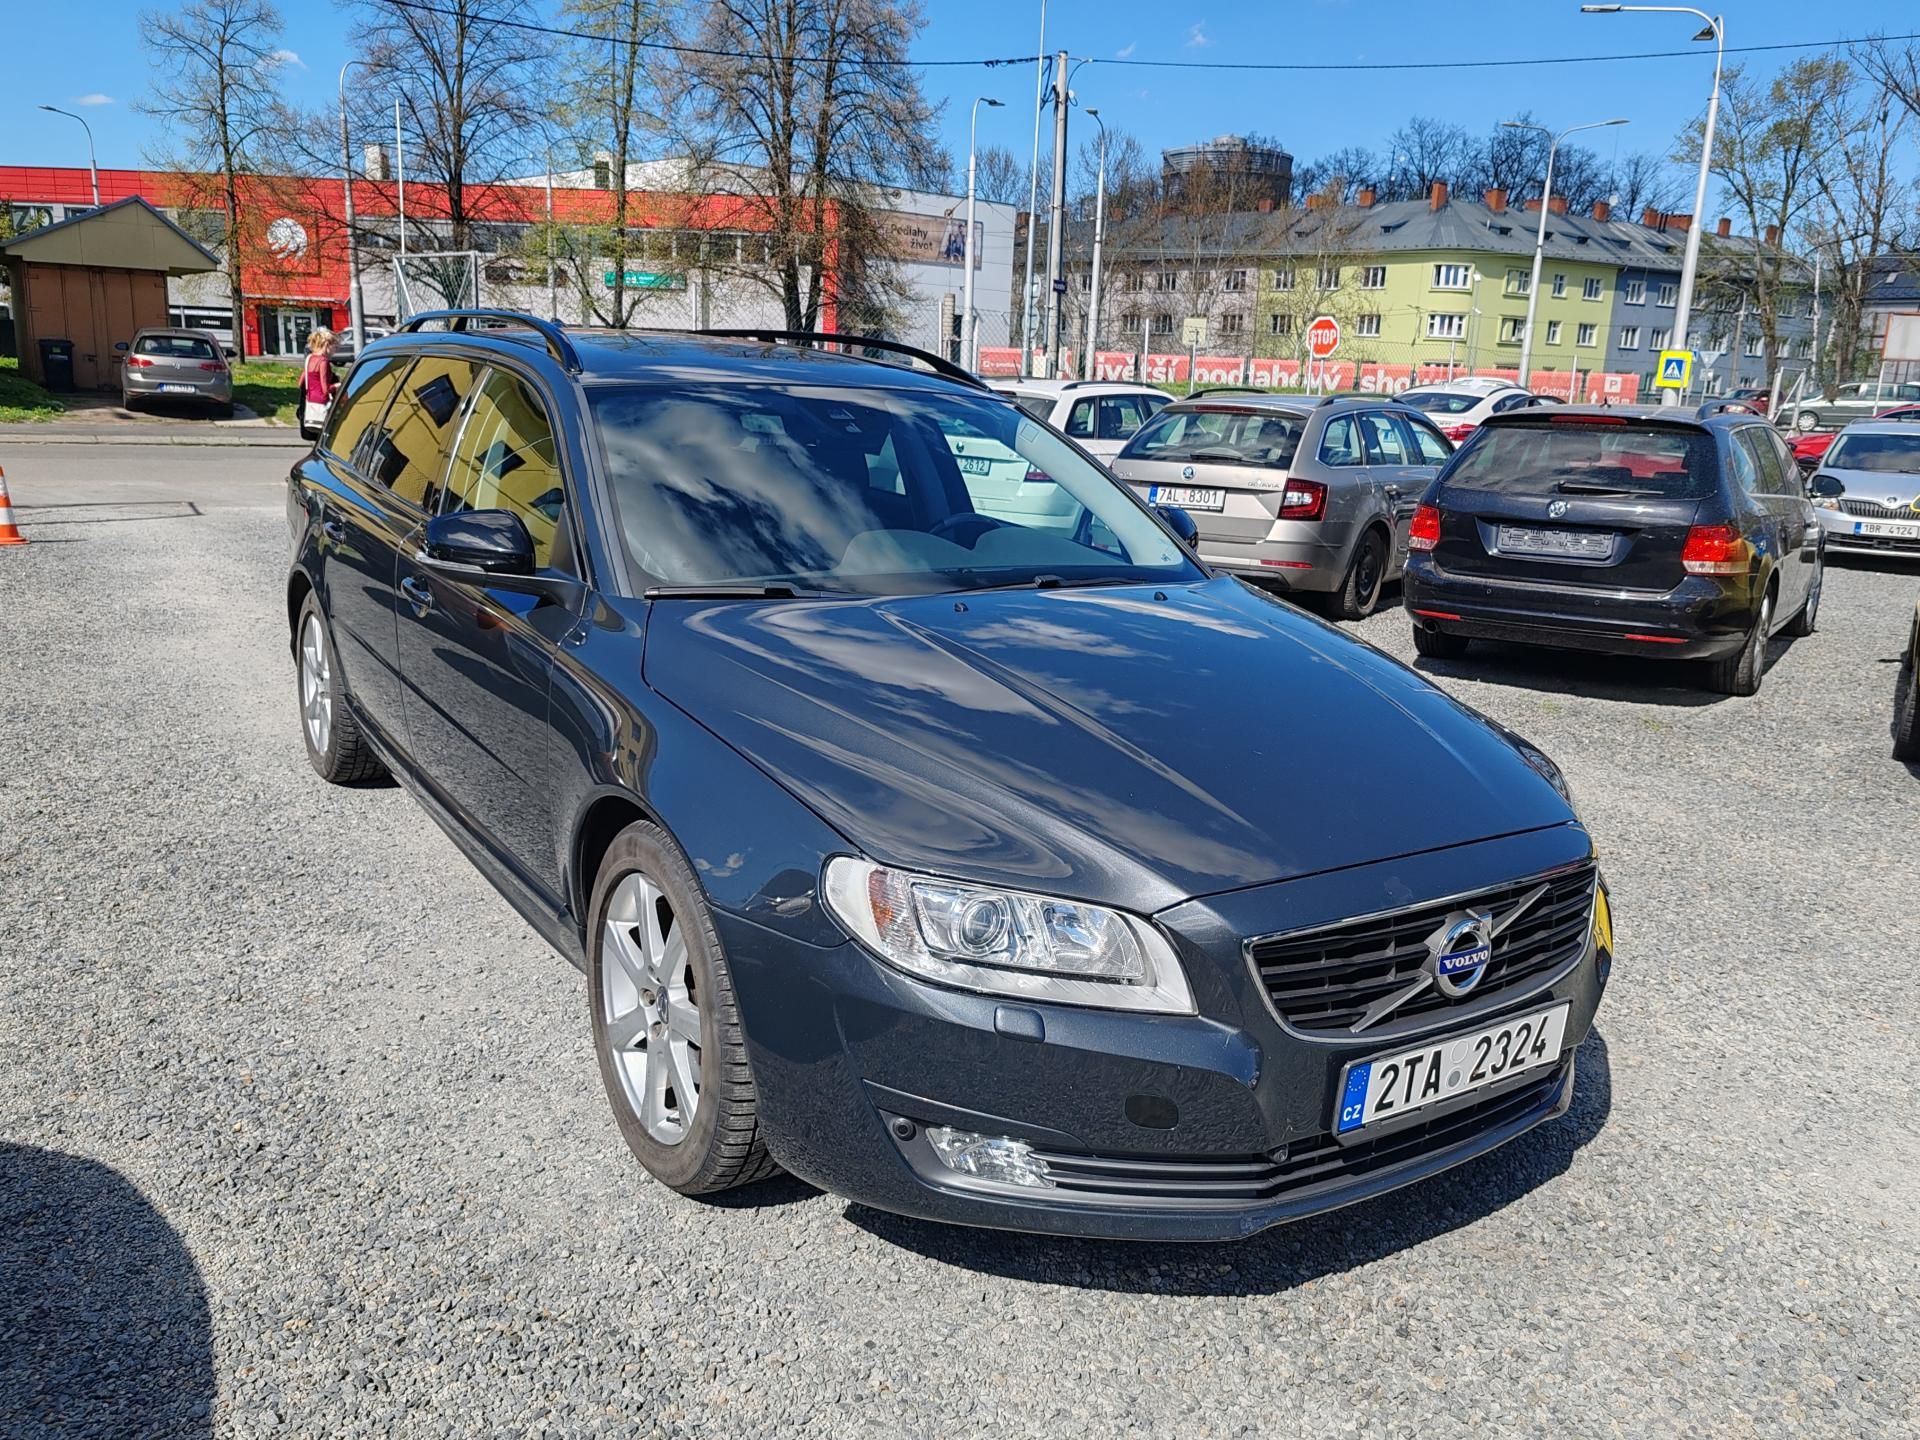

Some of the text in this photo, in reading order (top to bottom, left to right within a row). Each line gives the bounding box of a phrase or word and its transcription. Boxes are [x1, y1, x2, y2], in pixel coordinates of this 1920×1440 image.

[891, 224, 928, 239] Podlahy
[910, 240, 933, 250] život
[1310, 328, 1337, 345] STOP
[963, 459, 985, 471] 2612
[1159, 487, 1218, 504] 7AL 8301
[1864, 524, 1913, 536] 1BR 4124
[1443, 950, 1488, 969] VOLVO
[1373, 1015, 1549, 1113] 2TA 2324
[1342, 1104, 1361, 1121] CZ
